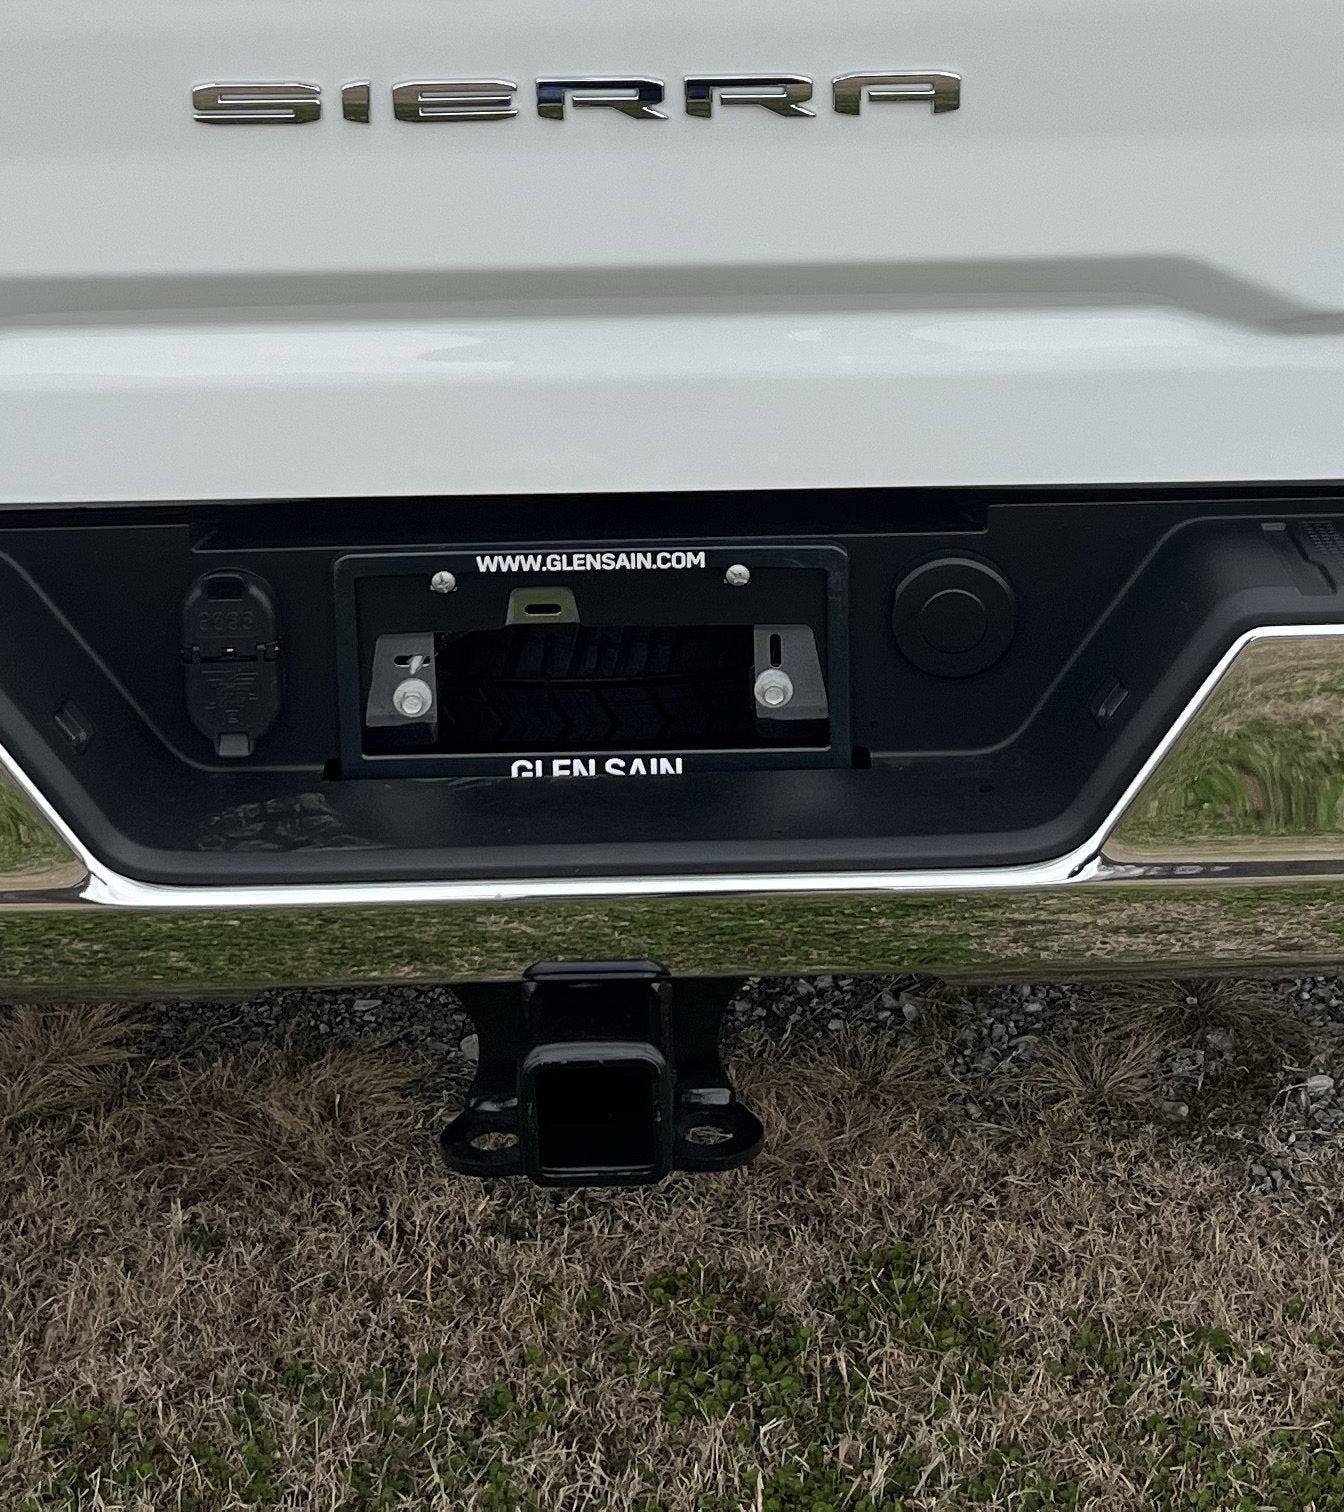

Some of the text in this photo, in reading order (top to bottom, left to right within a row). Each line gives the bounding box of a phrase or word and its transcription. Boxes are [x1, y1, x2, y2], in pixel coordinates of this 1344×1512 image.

[191, 71, 963, 125] SIERRA
[476, 551, 706, 573] WWW.GLENSAIN.COM
[511, 757, 683, 778] GLEN SAIN
